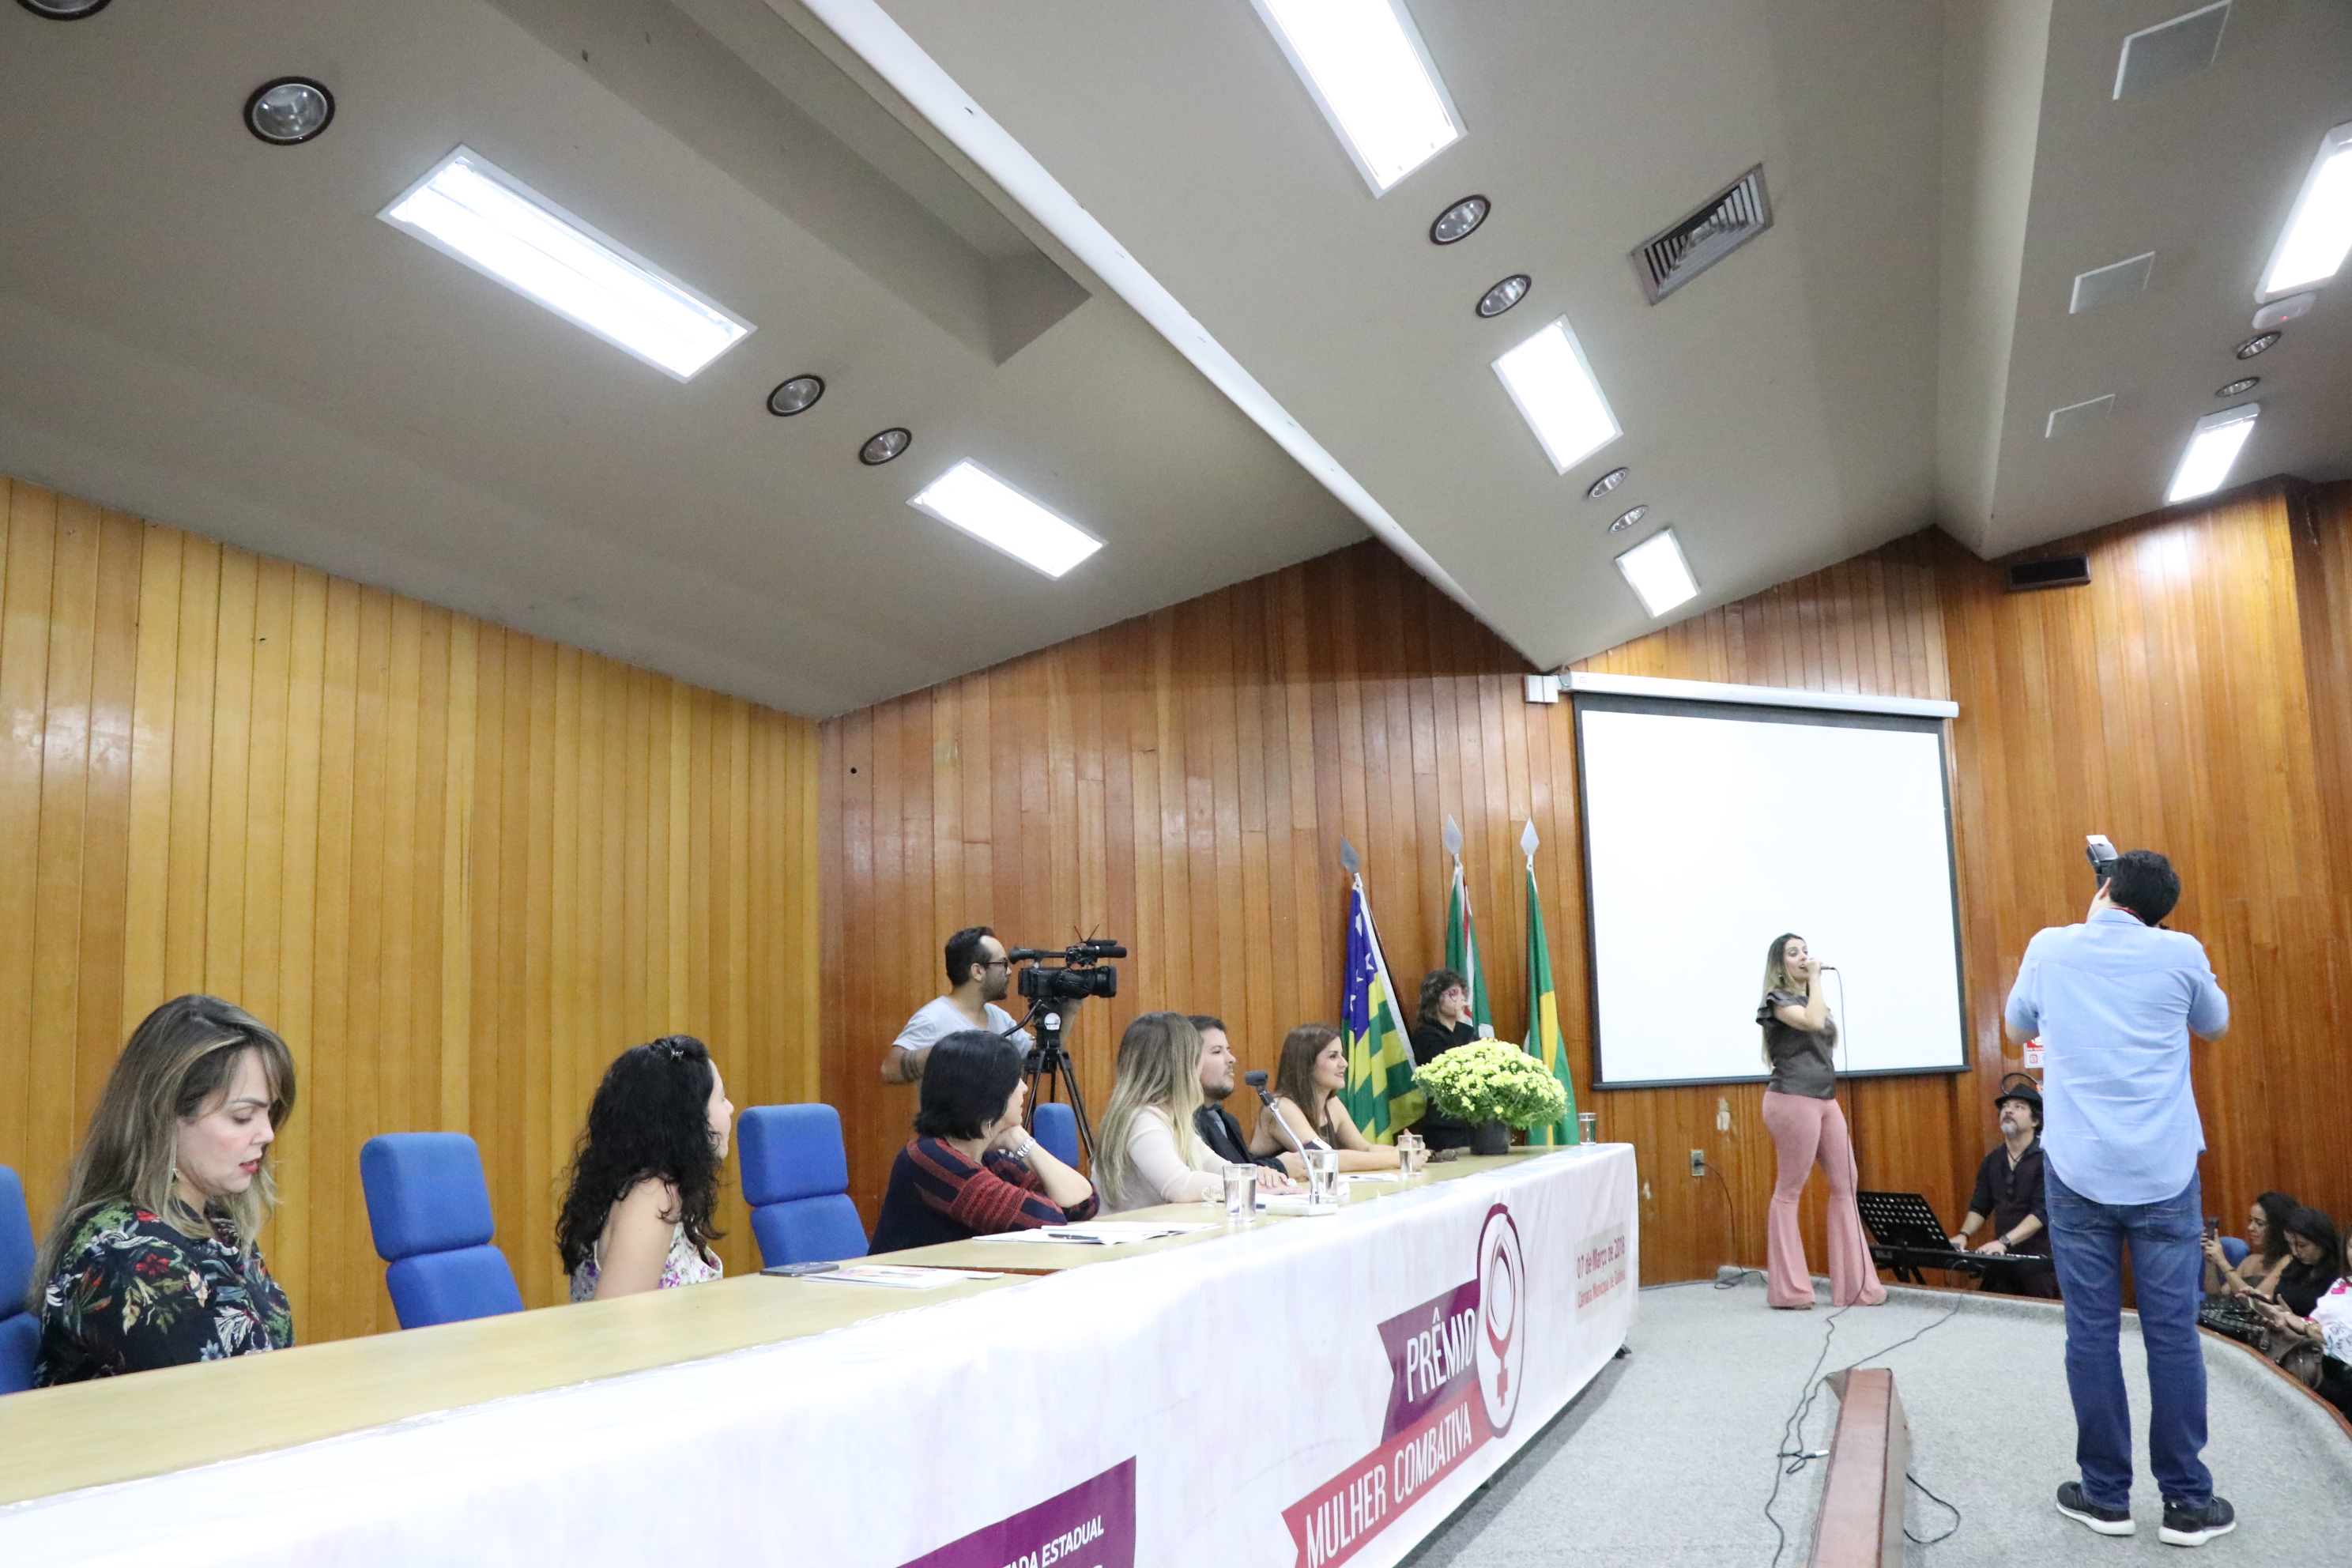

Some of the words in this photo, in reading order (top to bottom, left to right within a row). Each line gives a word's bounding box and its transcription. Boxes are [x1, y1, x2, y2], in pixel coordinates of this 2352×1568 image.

[1577, 1255, 1585, 1279] 07
[1585, 1253, 1592, 1275] de
[1592, 1248, 1607, 1272] Março
[1407, 1306, 1476, 1403] PRÊMIO
[1306, 1464, 1386, 1568] MULHER
[1394, 1401, 1472, 1503] COMBATIVA
[1042, 1515, 1104, 1568] ESTADUAL
